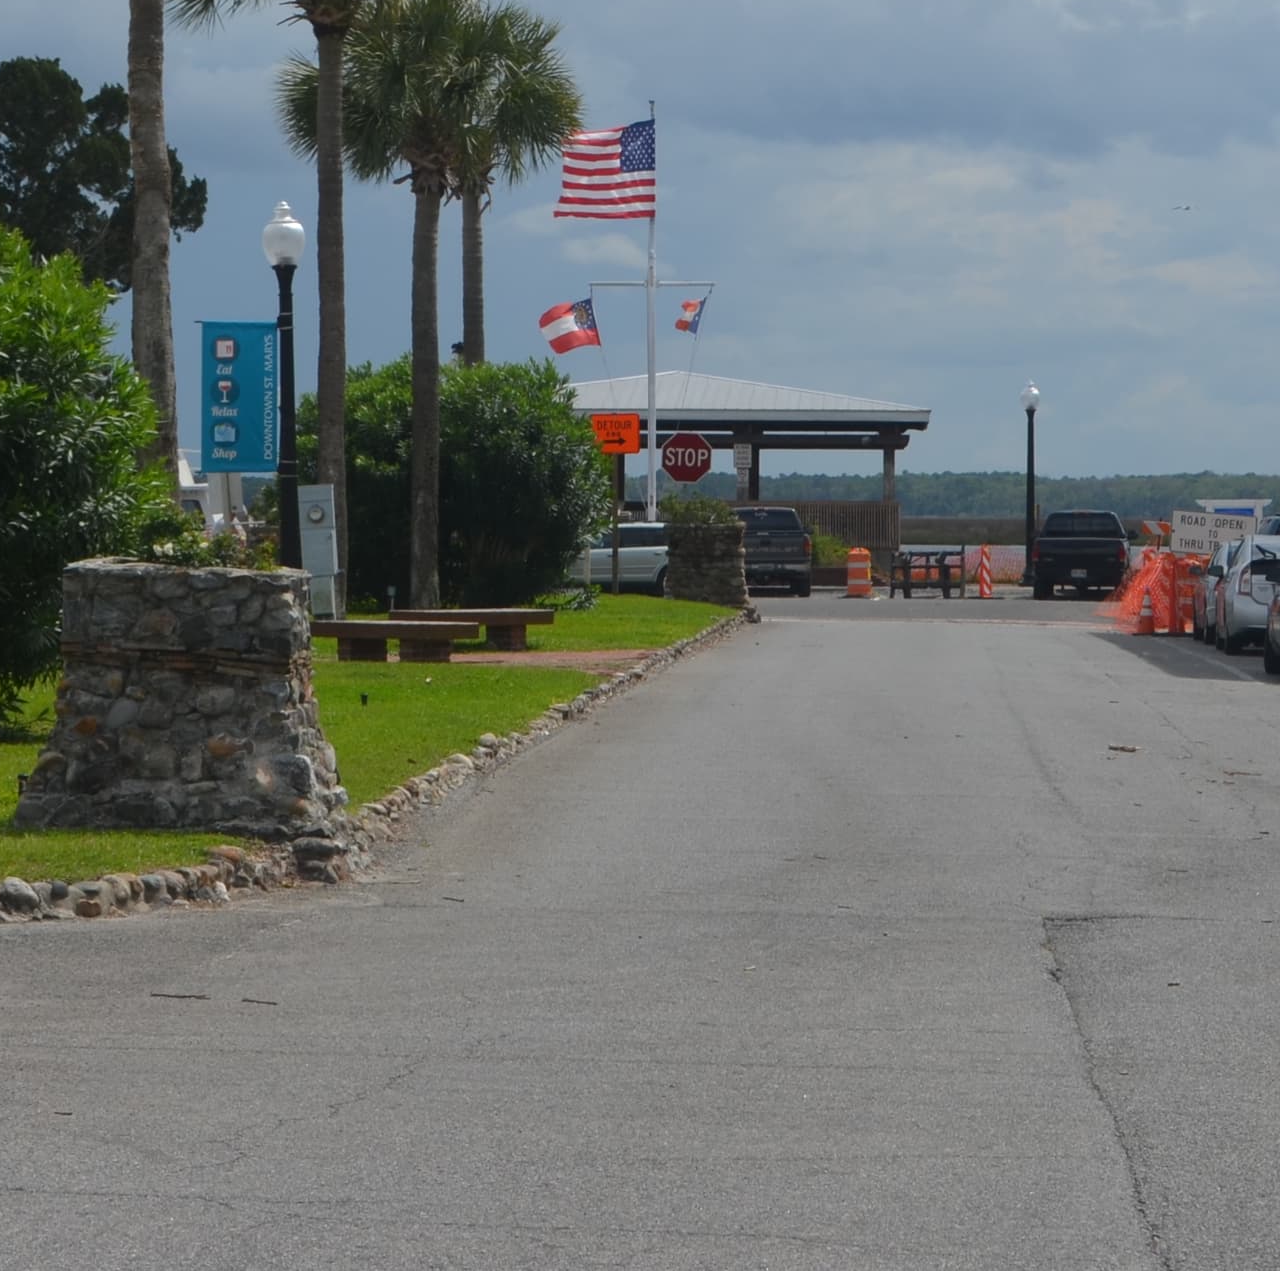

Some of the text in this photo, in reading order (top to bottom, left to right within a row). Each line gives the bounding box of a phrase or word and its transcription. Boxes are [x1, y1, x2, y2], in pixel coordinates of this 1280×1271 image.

[215, 364, 233, 376] Eat
[264, 334, 273, 460] DOWNTOWN ST. MARYS
[211, 406, 239, 417] Relax
[596, 420, 632, 431] DETOUR
[212, 448, 237, 461] Shop
[665, 447, 709, 467] STOP
[1180, 514, 1244, 530] ROAD OPEN
[1208, 529, 1218, 538] TO
[1179, 538, 1204, 549] THRU
